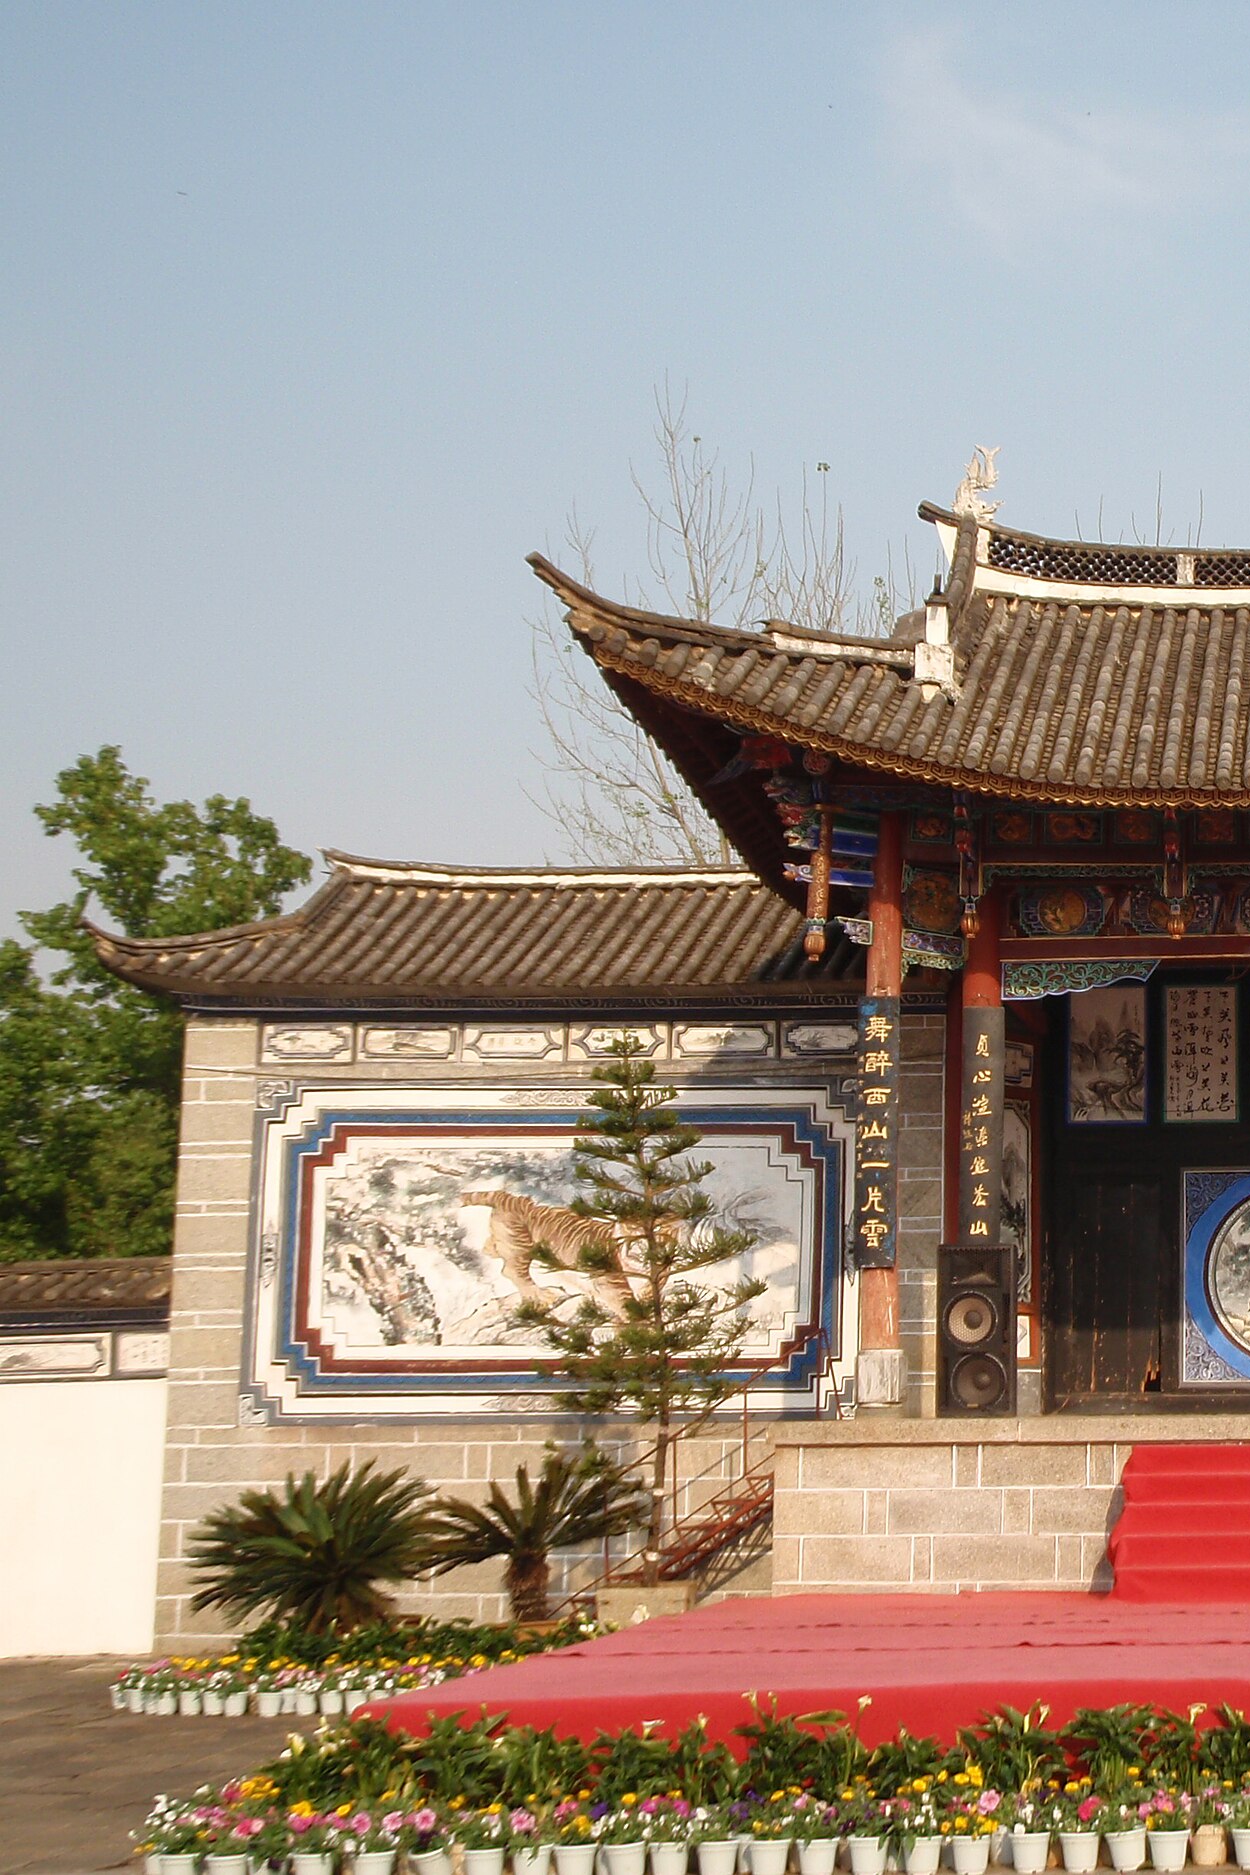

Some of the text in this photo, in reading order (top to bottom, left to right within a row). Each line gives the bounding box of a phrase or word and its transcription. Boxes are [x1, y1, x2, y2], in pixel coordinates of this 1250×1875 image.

[860, 1015, 893, 1248] 舞醉西山一片雲
